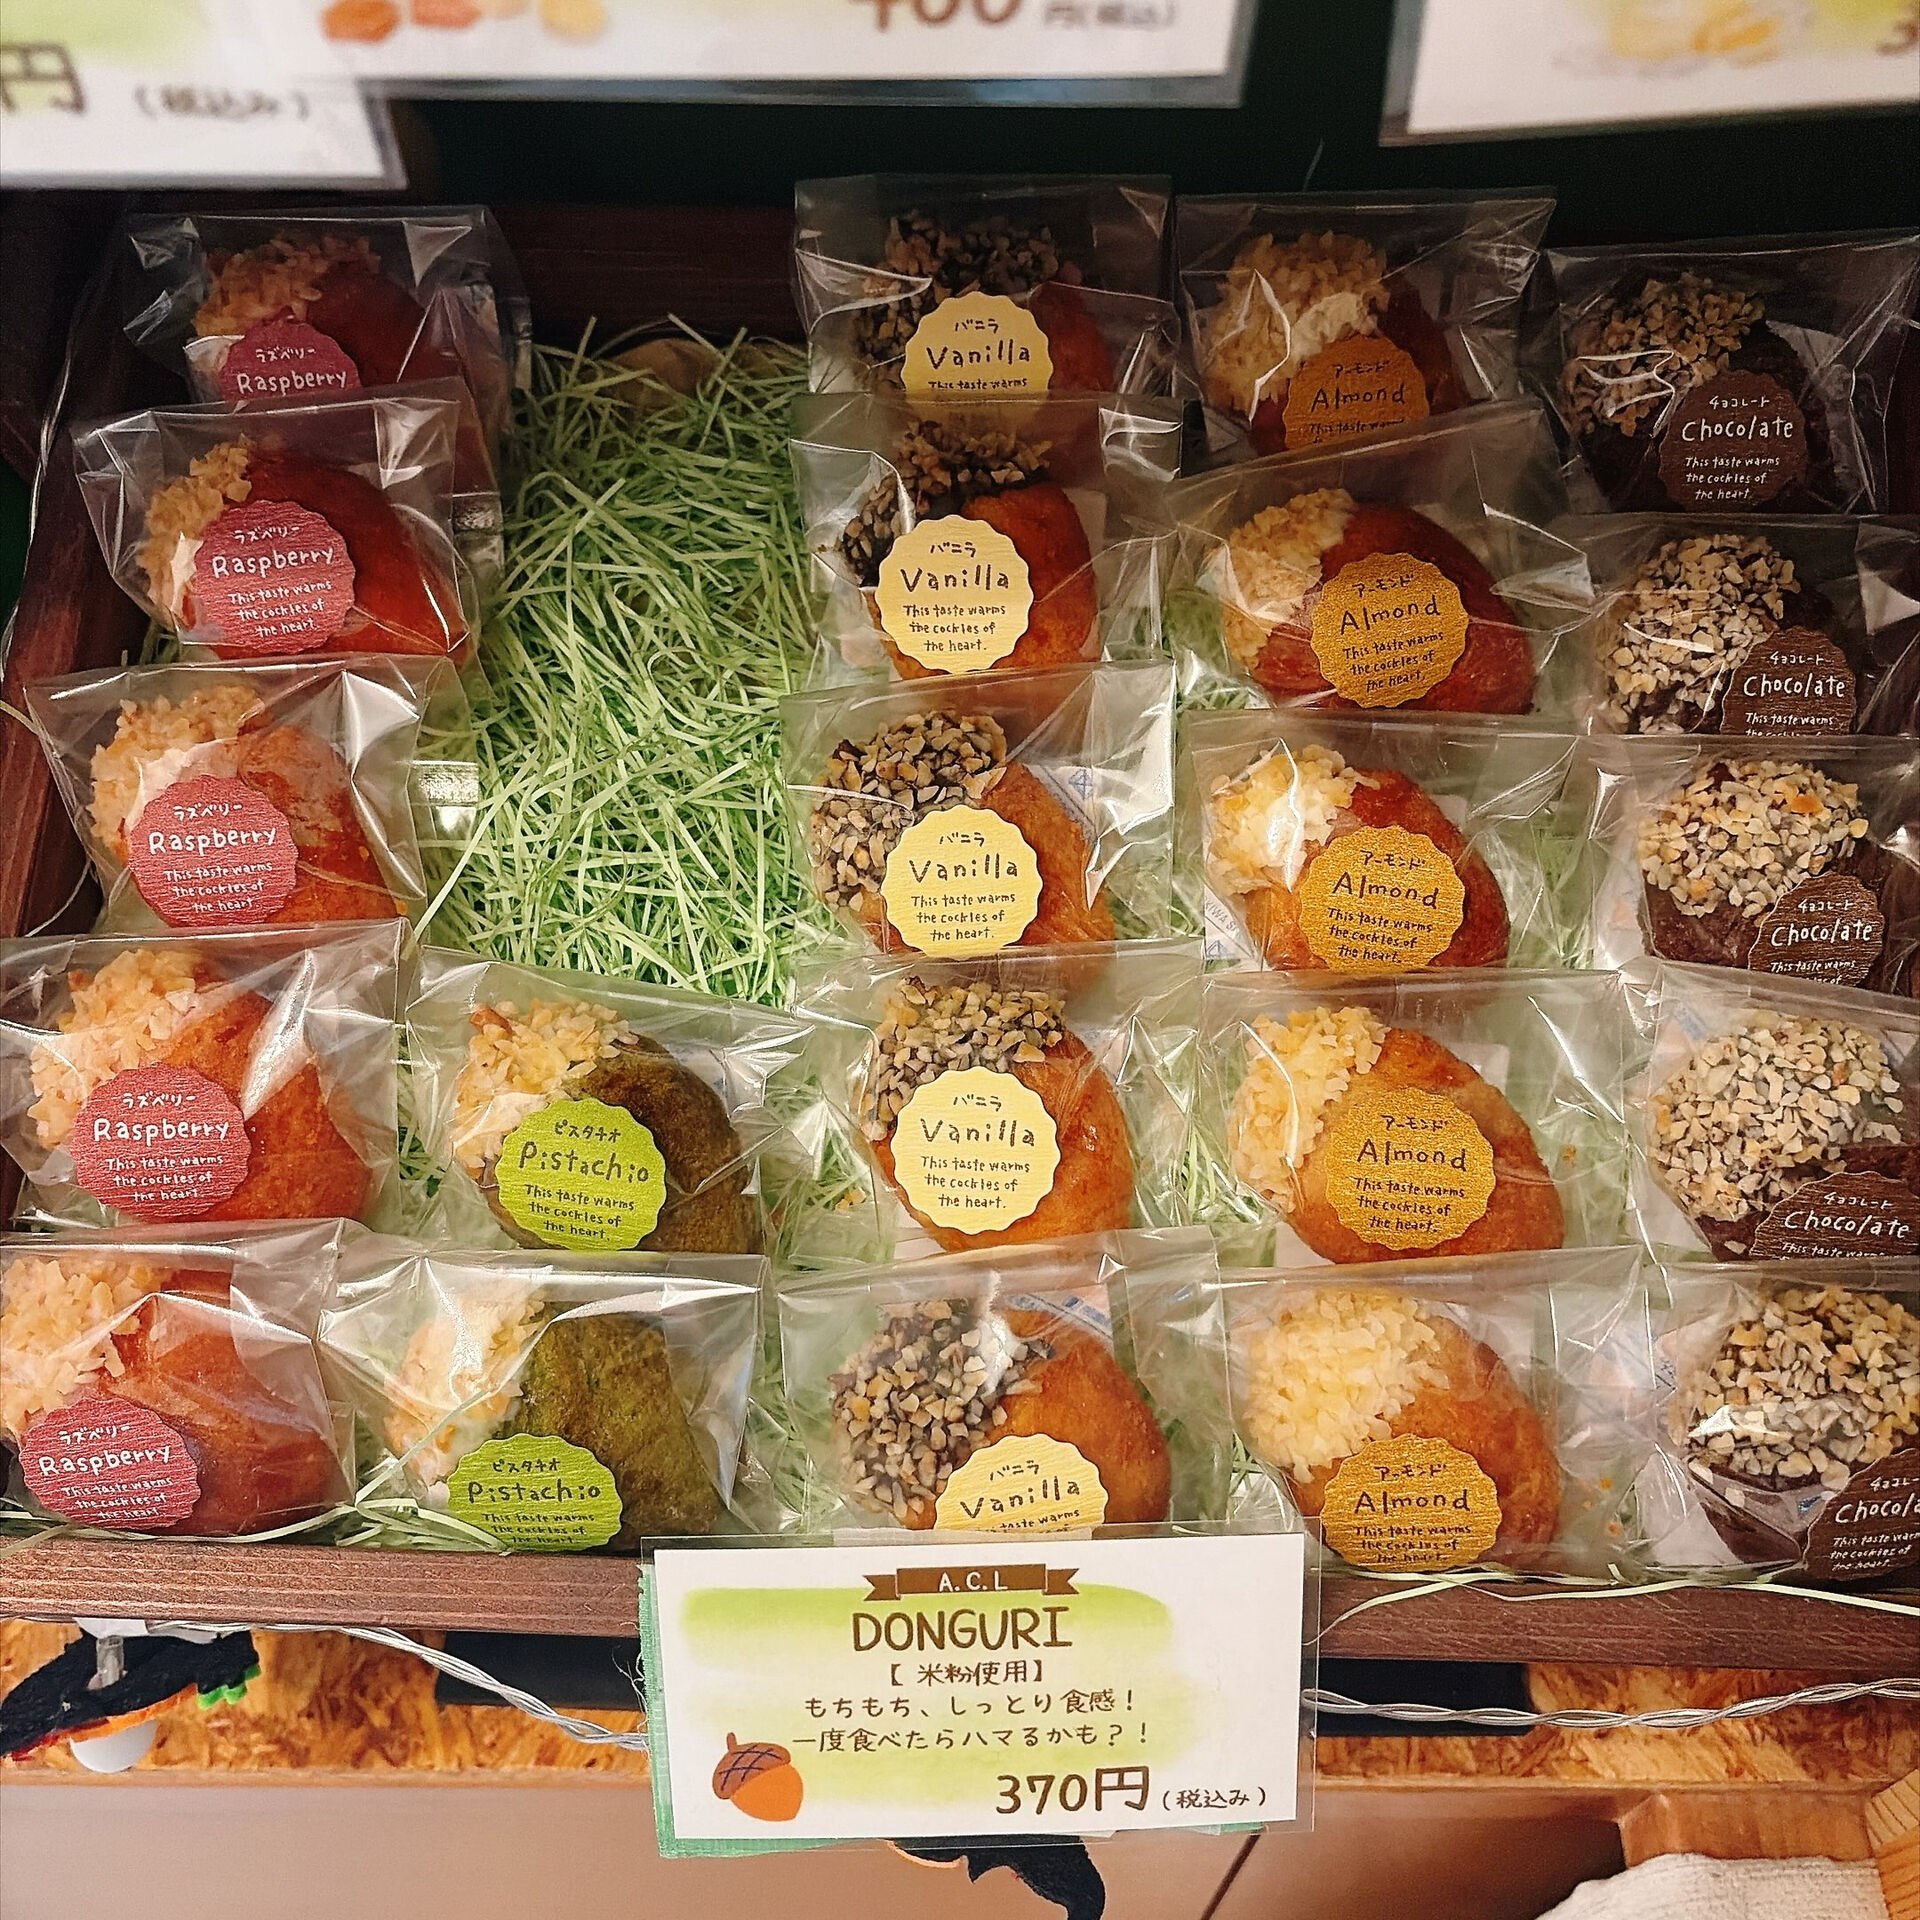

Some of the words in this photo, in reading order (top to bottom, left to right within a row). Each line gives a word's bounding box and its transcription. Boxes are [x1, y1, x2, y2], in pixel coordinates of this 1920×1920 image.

[954, 318, 999, 334] バニラ
[256, 346, 316, 362] ラズベリー
[926, 338, 1030, 369] Vanilla
[237, 370, 346, 396] Raspberry
[1311, 383, 1405, 412] Almond
[1682, 415, 1793, 441] Chocolate
[1685, 457, 1709, 468] This
[1712, 457, 1742, 468] taste
[1745, 457, 1780, 466] warms
[1686, 473, 1704, 483] the
[1755, 473, 1767, 484] of
[1695, 489, 1712, 500] the
[234, 525, 299, 544] ラズベリー
[930, 542, 976, 557] バニラ
[212, 547, 333, 579] Raspberry
[900, 564, 1009, 592] Vanilla
[228, 593, 255, 605] This
[258, 586, 290, 602] taste
[294, 580, 331, 596] warms
[237, 608, 258, 621] the
[311, 598, 324, 611] of
[903, 604, 929, 618] This
[933, 604, 964, 618] taste
[968, 605, 1006, 616] warms
[1340, 594, 1440, 635] Almond
[256, 625, 277, 637] the
[909, 621, 929, 633] the
[933, 623, 979, 634] cockles
[983, 622, 996, 634] of
[924, 640, 944, 651] the
[949, 639, 987, 651] heart.
[1343, 647, 1369, 659] This
[1372, 640, 1403, 654] taste
[1407, 632, 1443, 647] warms
[1350, 664, 1370, 675] the
[1422, 650, 1435, 662] of
[1744, 673, 1845, 697] Chocolate
[1745, 712, 1768, 724] This
[1771, 714, 1797, 725] taste
[1800, 716, 1834, 725] warms
[173, 802, 242, 821] ラズベリー
[149, 828, 276, 857] Raspberry
[939, 832, 985, 847] バニラ
[164, 870, 190, 881] This
[194, 866, 229, 878] taste
[233, 862, 272, 875] warms
[909, 853, 1018, 883] Vanilla
[172, 885, 194, 897] the
[251, 878, 264, 890] of
[1332, 872, 1439, 909] Almond
[192, 903, 213, 913] the
[911, 895, 938, 908] This
[942, 894, 972, 907] taste
[977, 894, 1015, 904] warms
[917, 912, 936, 923] the
[941, 912, 988, 923] cockles
[992, 910, 1005, 921] of
[1328, 907, 1353, 921] This
[1357, 912, 1388, 928] taste
[1393, 921, 1432, 932] warms
[930, 929, 950, 941] the
[956, 927, 994, 940] heart.
[1329, 925, 1350, 938] the
[1404, 937, 1417, 948] of
[1771, 918, 1872, 946] Chocolate
[1338, 945, 1357, 957] the
[1771, 962, 1792, 973] This
[1795, 961, 1821, 971] taste
[1824, 960, 1855, 969] warms
[123, 1091, 195, 1108] ラズベリー
[953, 1094, 1002, 1111] バニラ
[93, 1118, 229, 1146] Raspberry
[554, 1119, 621, 1143] ピスタチオ
[920, 1118, 1034, 1147] Vanilla
[106, 1159, 136, 1171] This
[140, 1157, 175, 1169] taste
[180, 1155, 223, 1168] warms
[519, 1141, 649, 1183] Pistachio
[921, 1155, 948, 1169] This
[952, 1157, 985, 1171] taste
[990, 1161, 1030, 1173] warms
[1357, 1139, 1467, 1172] Almond
[112, 1174, 136, 1186] the
[141, 1173, 194, 1186] cockles
[198, 1170, 212, 1182] of
[925, 1173, 945, 1187] the
[950, 1178, 999, 1191] cockles
[1004, 1179, 1018, 1191] of
[1354, 1178, 1381, 1191] This
[1386, 1180, 1420, 1195] taste
[1424, 1187, 1464, 1197] warms
[132, 1191, 155, 1202] the
[524, 1184, 552, 1197] This
[556, 1190, 589, 1205] taste
[594, 1197, 634, 1210] warms
[938, 1194, 959, 1206] the
[965, 1195, 1006, 1208] heart.
[1357, 1196, 1379, 1208] the
[1437, 1204, 1451, 1216] of
[529, 1202, 550, 1214] the
[555, 1208, 603, 1224] cockles
[608, 1216, 621, 1227] of
[1369, 1216, 1390, 1228] the
[1395, 1218, 1437, 1232] heart.
[1784, 1210, 1910, 1238] Chocolate
[544, 1220, 564, 1231] the
[570, 1224, 610, 1241] heart.
[58, 1424, 130, 1445] ラズベリー
[39, 1445, 170, 1476] Raspberry
[990, 1460, 1039, 1481] バニラ
[61, 1487, 91, 1497] This
[93, 1483, 127, 1494] taste
[468, 1478, 601, 1503] Pistachio
[960, 1475, 1080, 1519] Vanilla
[1354, 1489, 1470, 1514] Almond
[483, 1513, 511, 1521] This
[1039, 1509, 1080, 1524] warms
[1354, 1526, 1383, 1536] This
[852, 1606, 1073, 1652] DONGURI
[996, 1765, 1150, 1815] 370円
